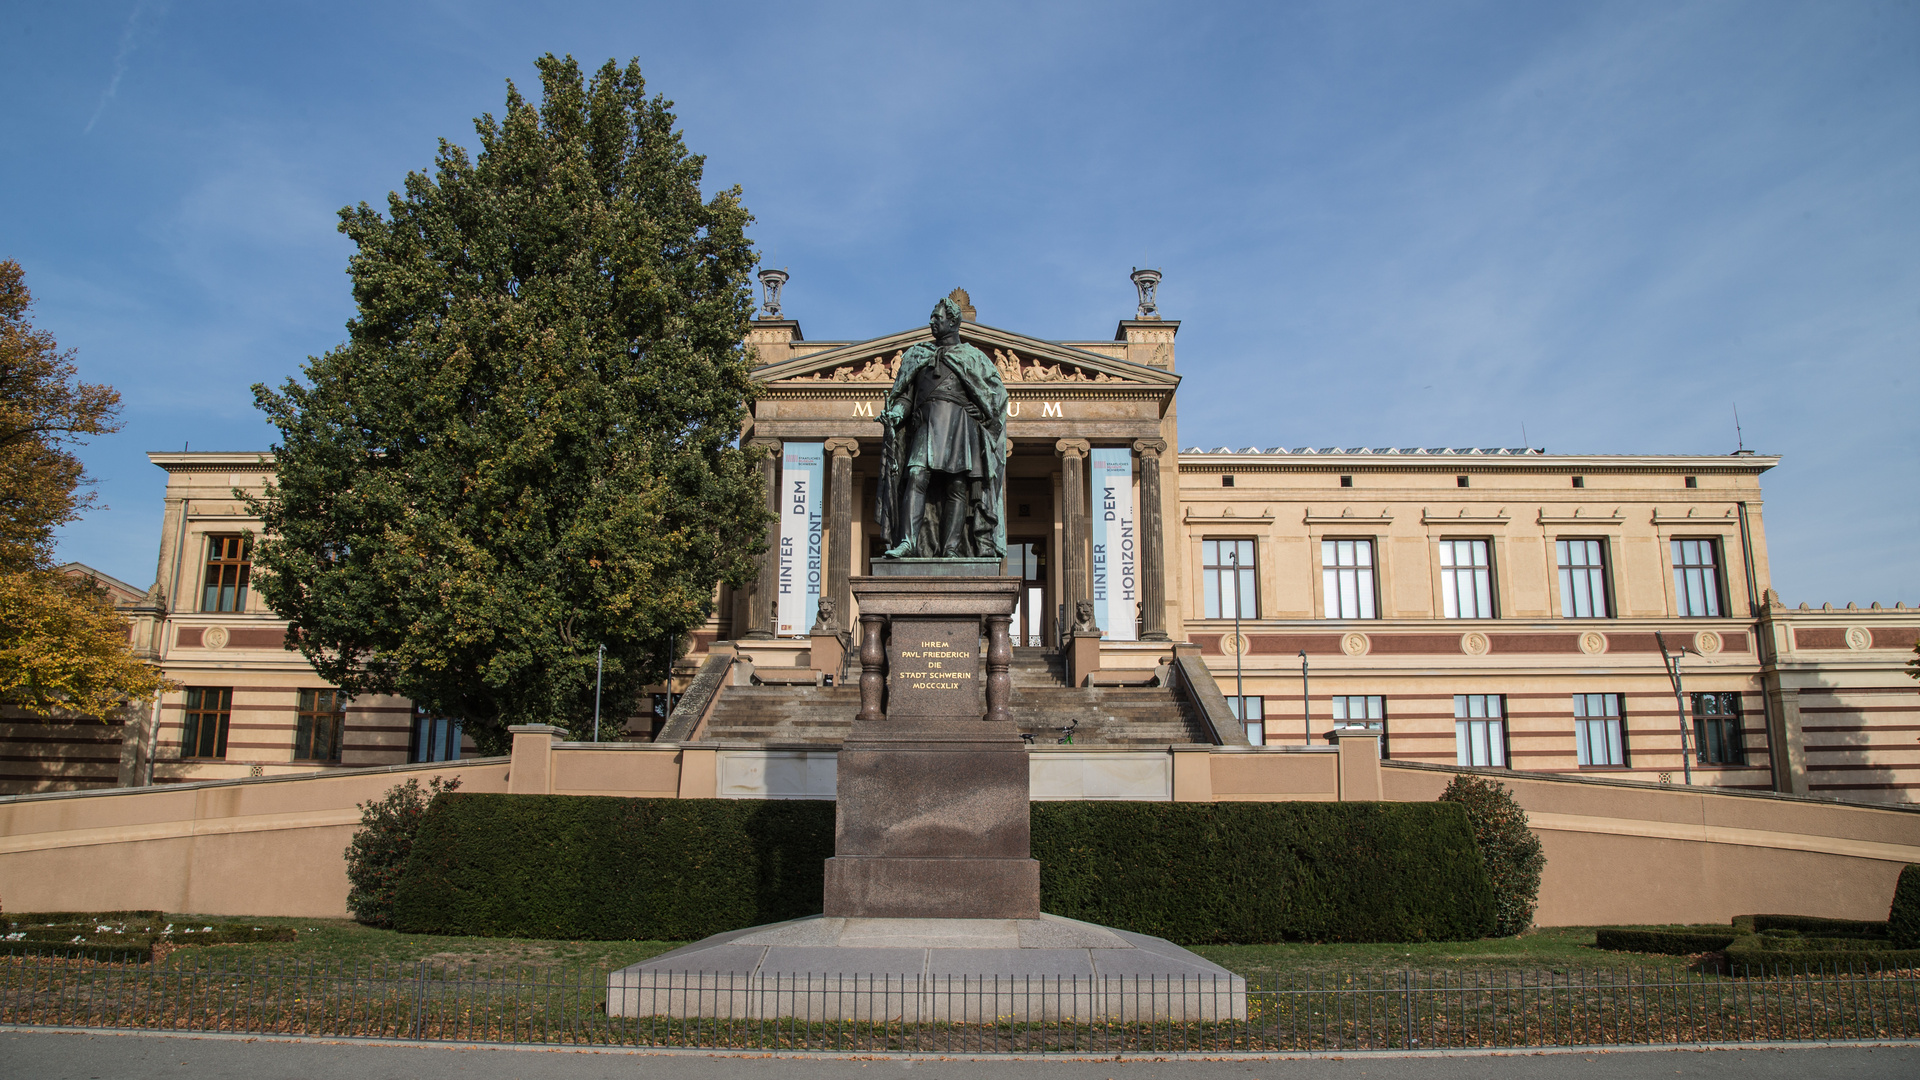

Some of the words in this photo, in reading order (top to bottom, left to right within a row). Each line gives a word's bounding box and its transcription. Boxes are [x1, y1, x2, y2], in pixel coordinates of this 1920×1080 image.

[852, 401, 1063, 418] MUM
[793, 481, 806, 514] DEM
[1104, 488, 1116, 521] DEM
[780, 536, 793, 594] HINTER
[1094, 544, 1106, 600] HINTER
